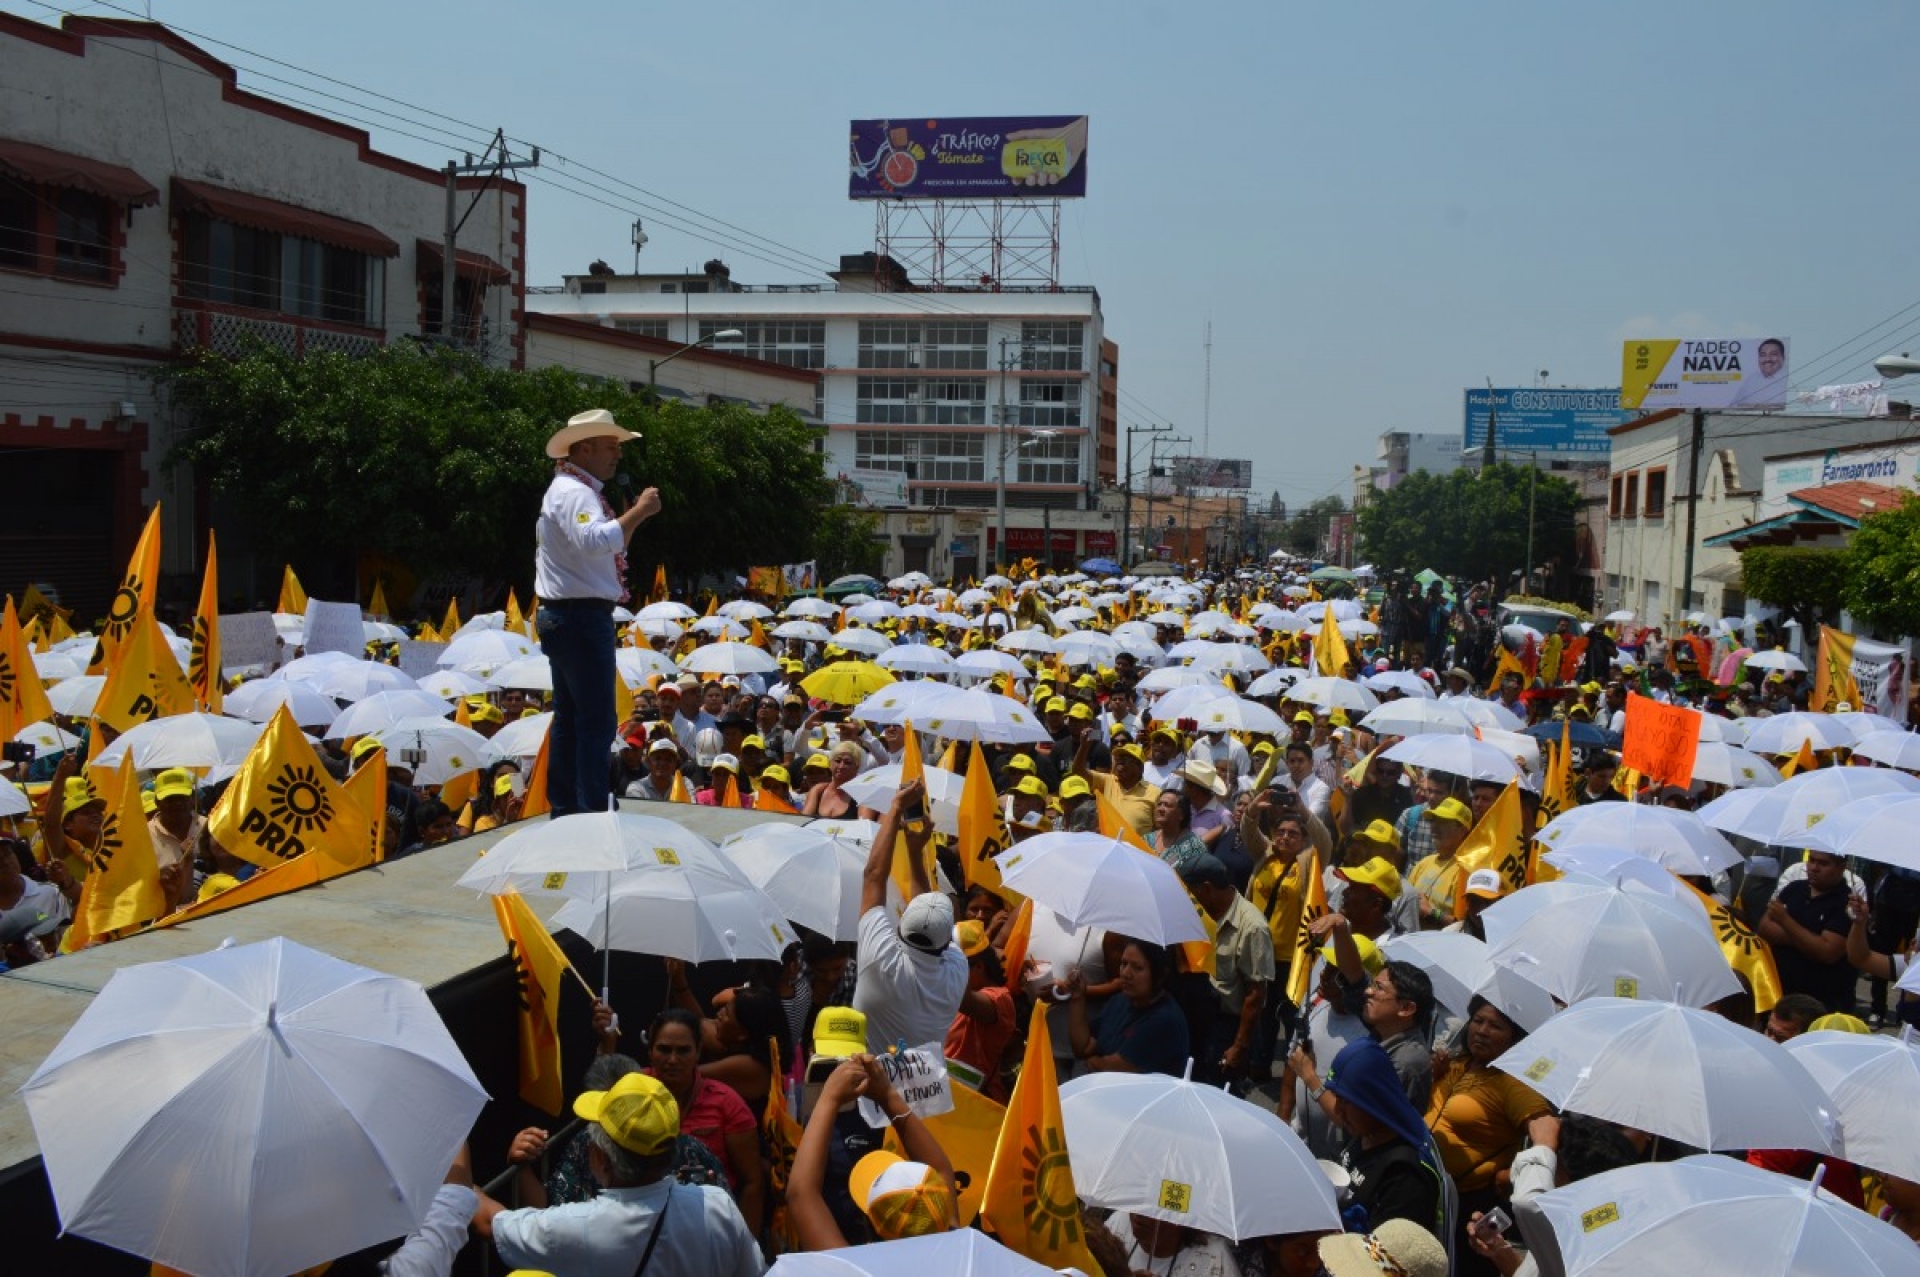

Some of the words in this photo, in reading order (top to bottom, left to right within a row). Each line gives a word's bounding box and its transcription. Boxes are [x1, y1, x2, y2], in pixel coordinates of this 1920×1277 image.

[931, 128, 1000, 155] ¿TRÁFICO?
[1015, 149, 1060, 167] FRESCA
[1685, 341, 1742, 354] TADEO
[1683, 356, 1742, 371] NAVA
[1511, 391, 1622, 411] CONSTITUYENTE
[1822, 458, 1897, 481] Farmapronto
[1008, 530, 1040, 540] ATLAS
[238, 807, 306, 860] PRD
